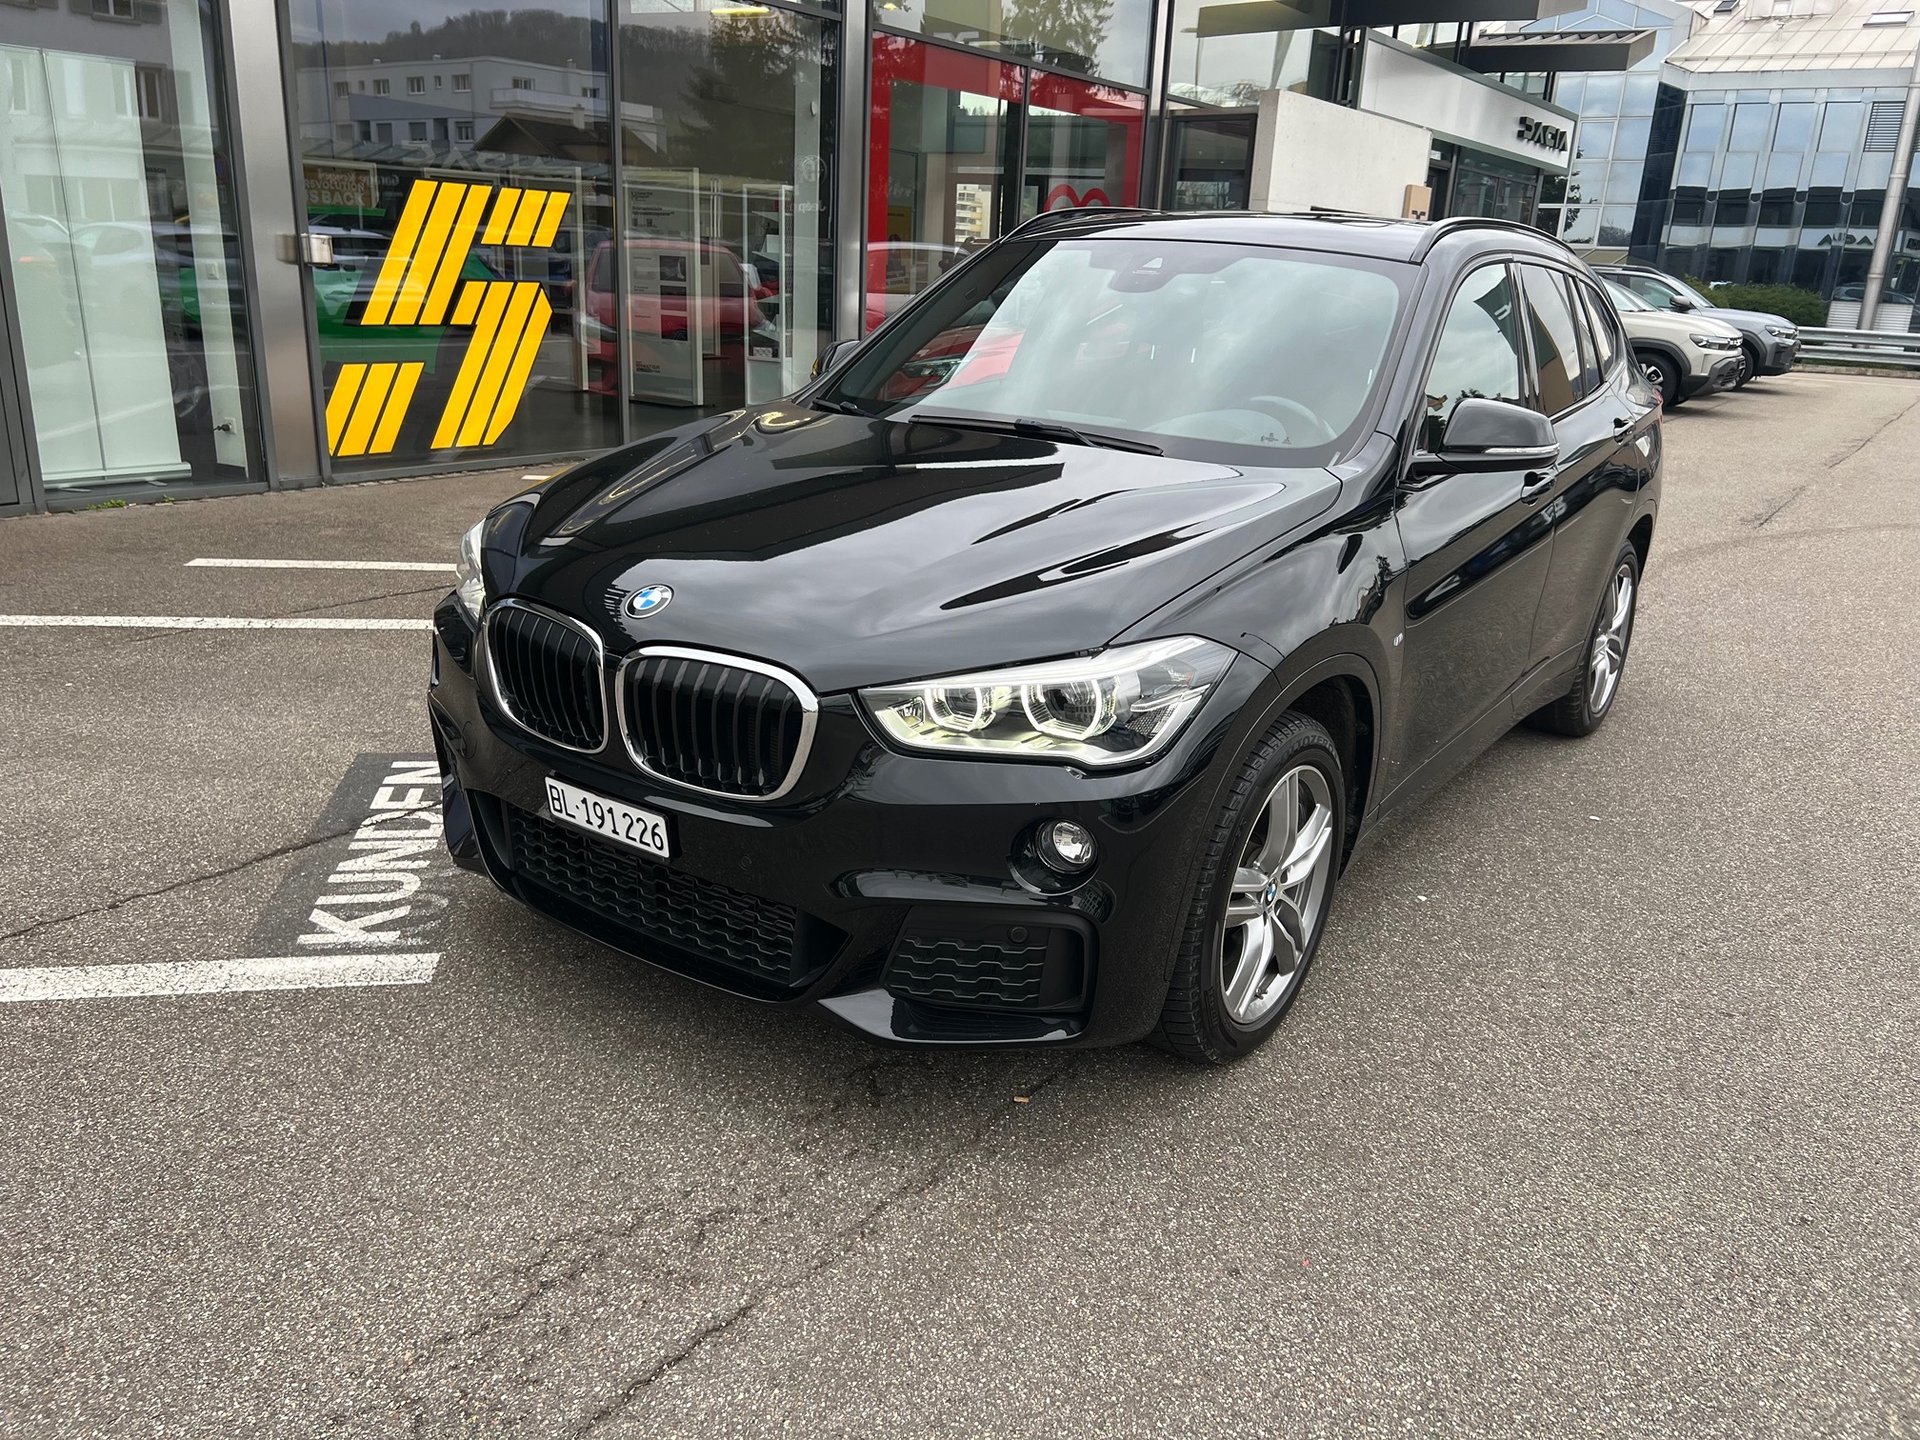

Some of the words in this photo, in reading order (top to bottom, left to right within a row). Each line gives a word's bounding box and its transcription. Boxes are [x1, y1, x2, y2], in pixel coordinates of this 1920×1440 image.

[1517, 116, 1568, 152] DACIA
[322, 190, 365, 206] BACK
[297, 760, 445, 945] KUNDEN
